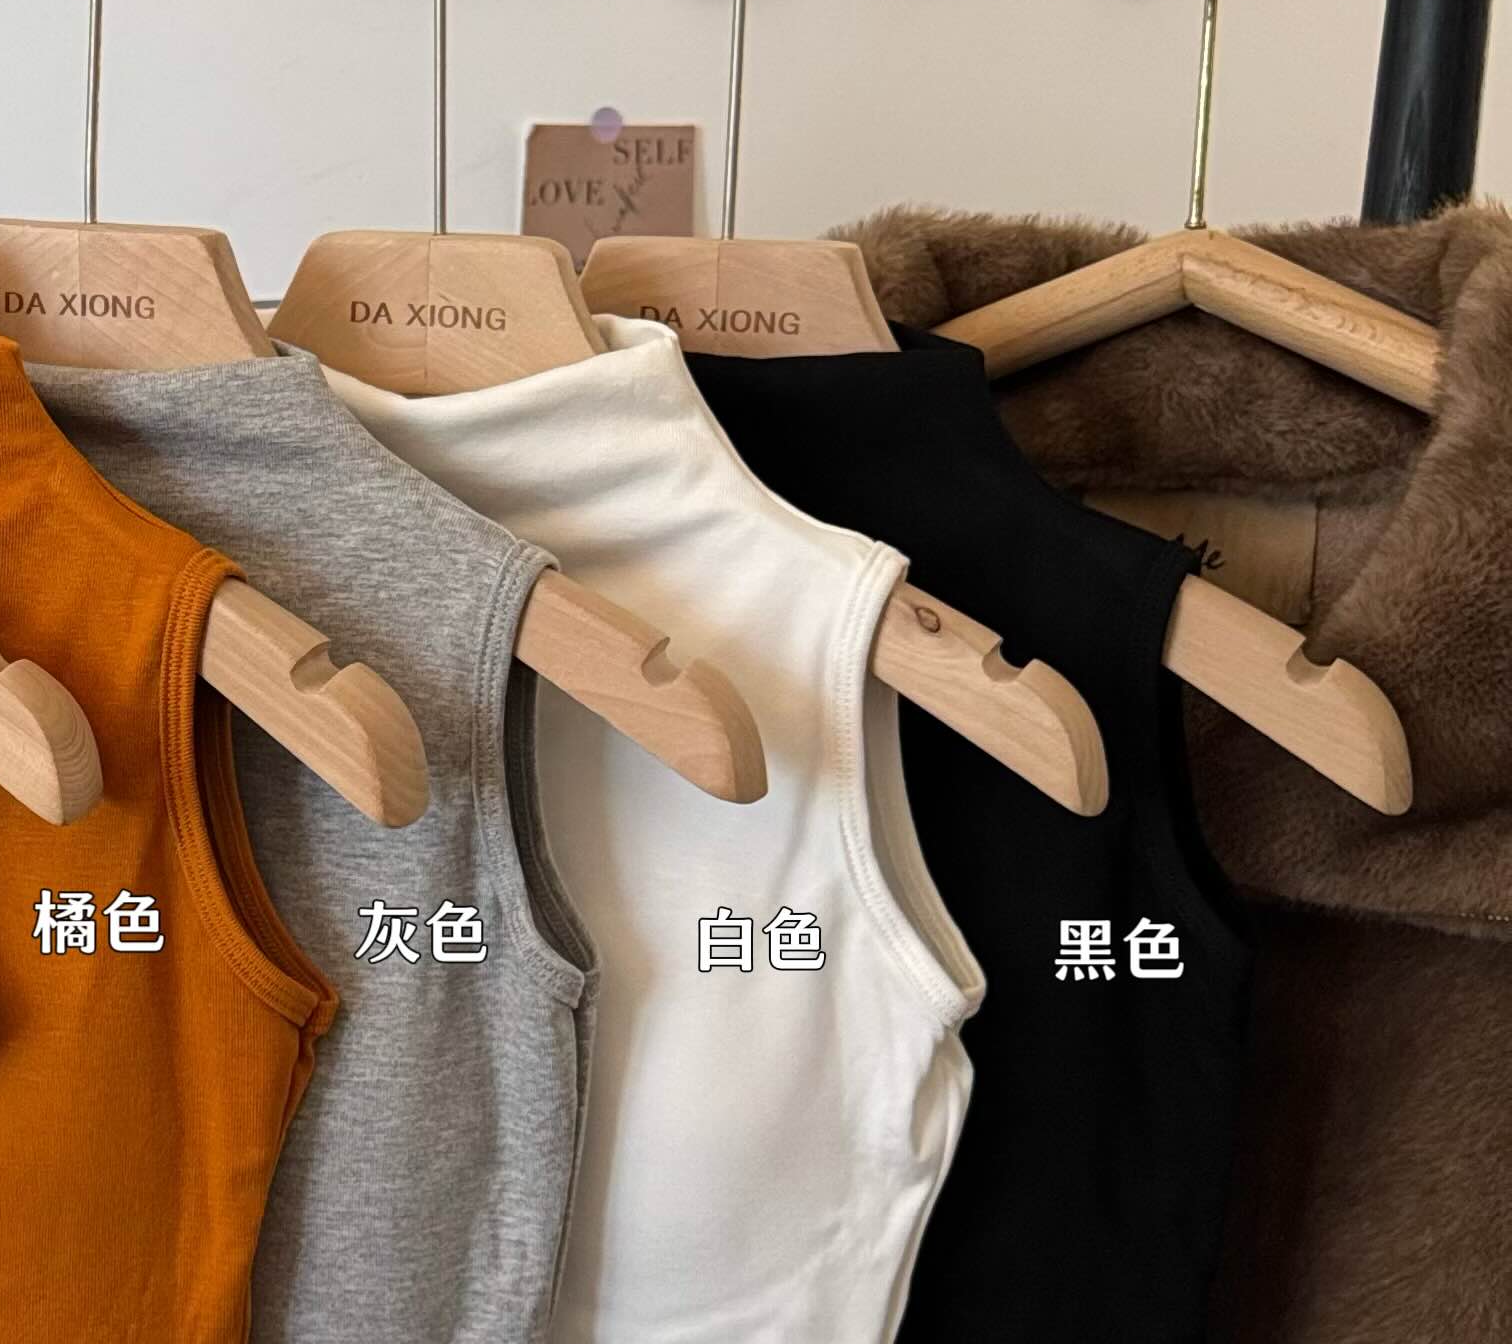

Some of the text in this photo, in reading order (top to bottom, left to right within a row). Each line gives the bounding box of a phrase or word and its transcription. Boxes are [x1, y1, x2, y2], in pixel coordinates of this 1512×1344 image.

[3, 291, 156, 320] DA XIONG
[350, 300, 507, 331] DA XIONG
[640, 306, 801, 335] DA XIONG
